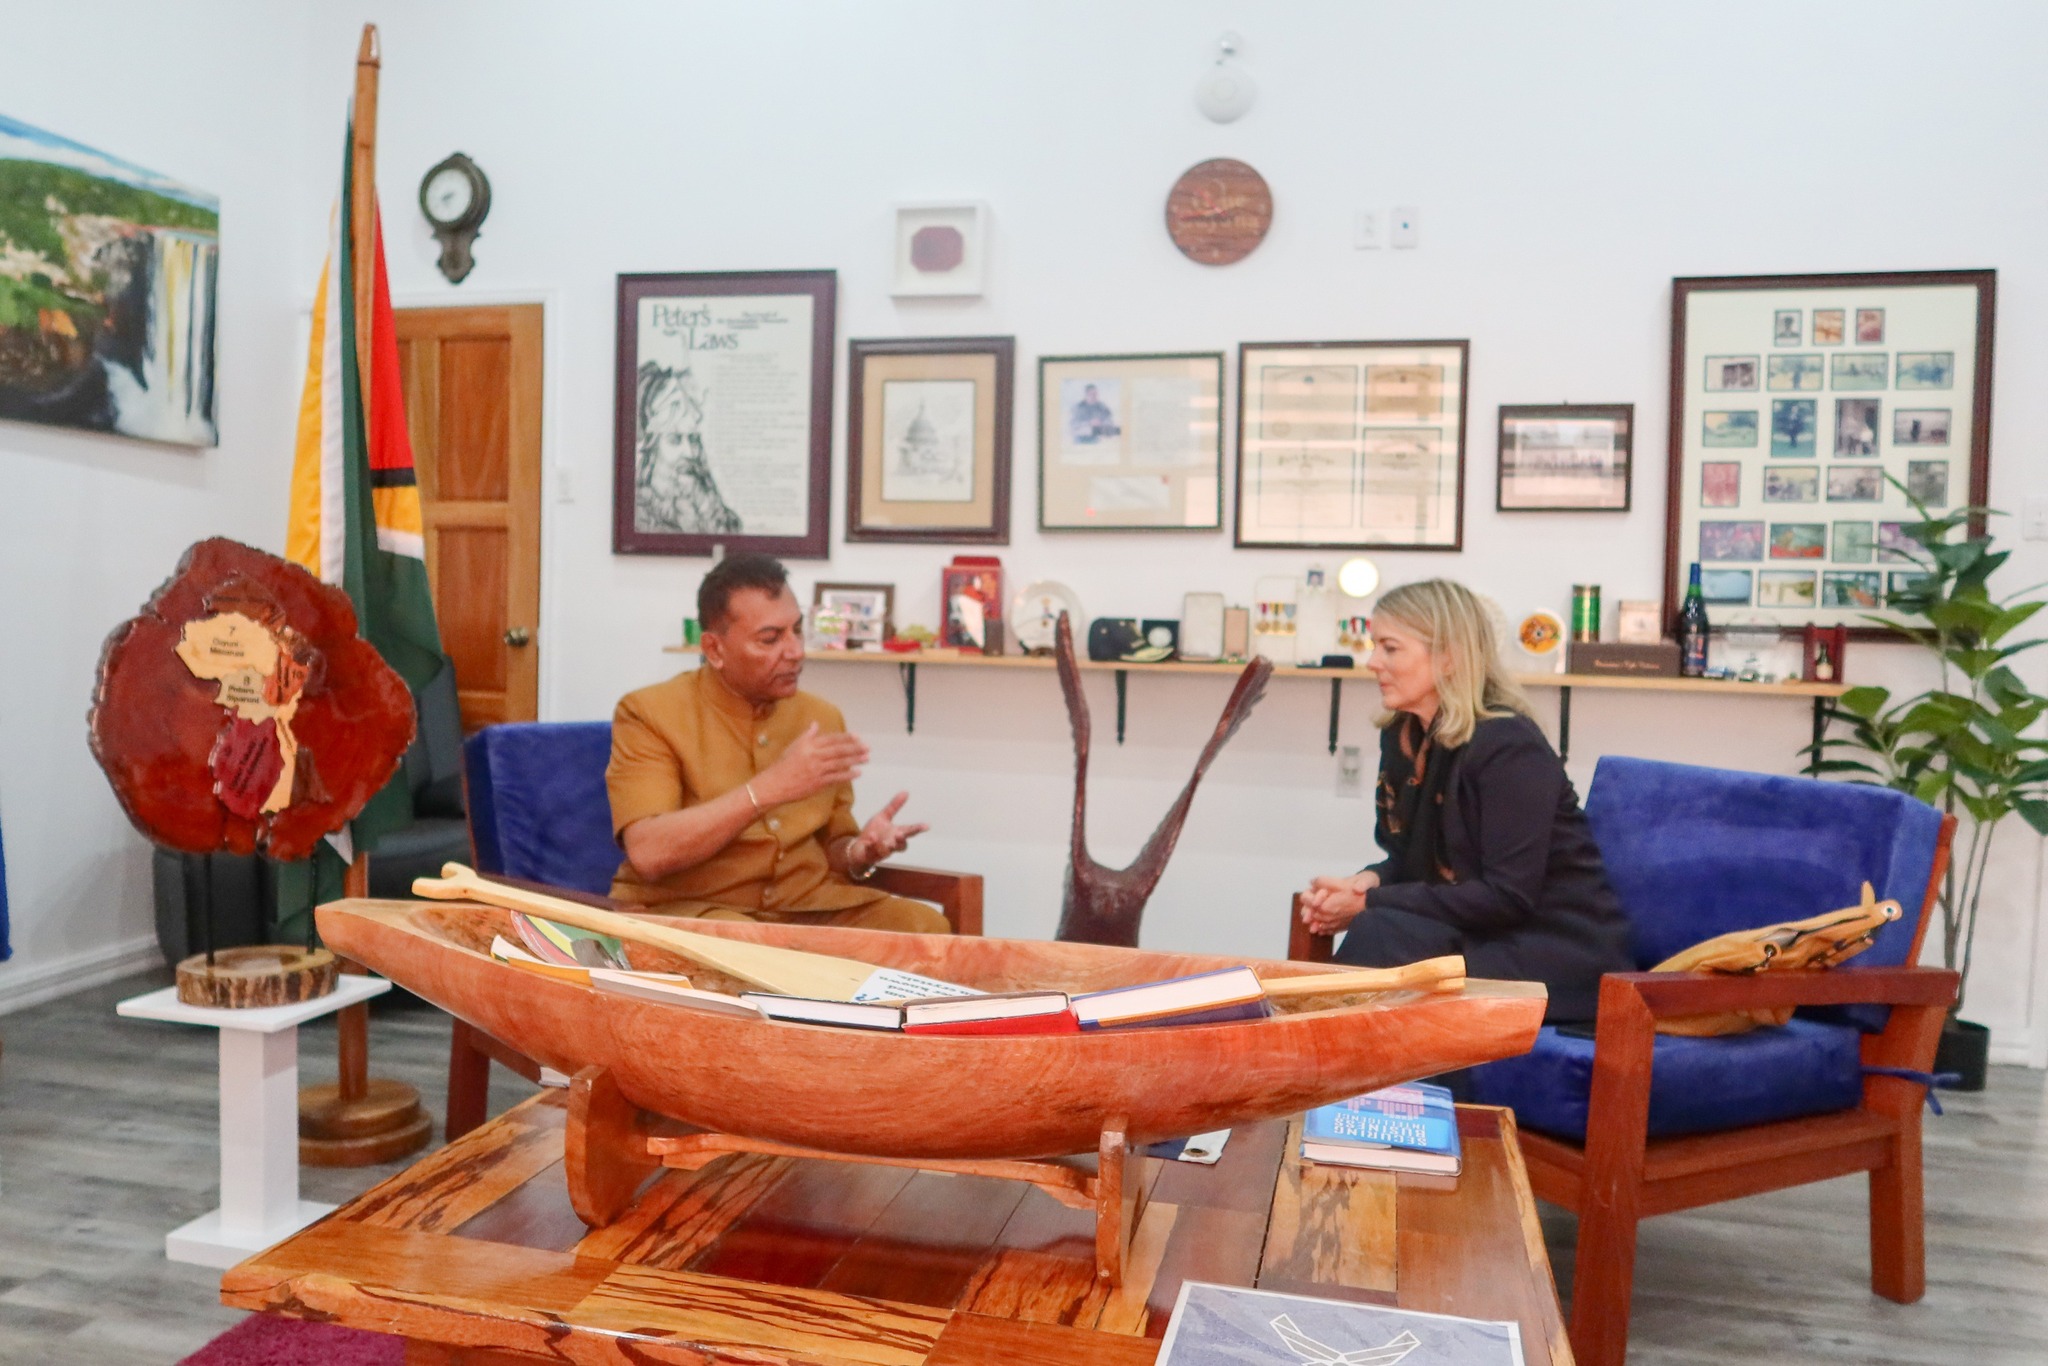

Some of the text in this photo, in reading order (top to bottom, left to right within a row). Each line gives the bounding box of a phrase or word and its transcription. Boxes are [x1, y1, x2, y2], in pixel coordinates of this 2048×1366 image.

[652, 303, 711, 327] Peter's
[688, 327, 738, 350] Laws
[1334, 1126, 1427, 1146] SECURING
[1335, 1117, 1426, 1138] BUSINESS
